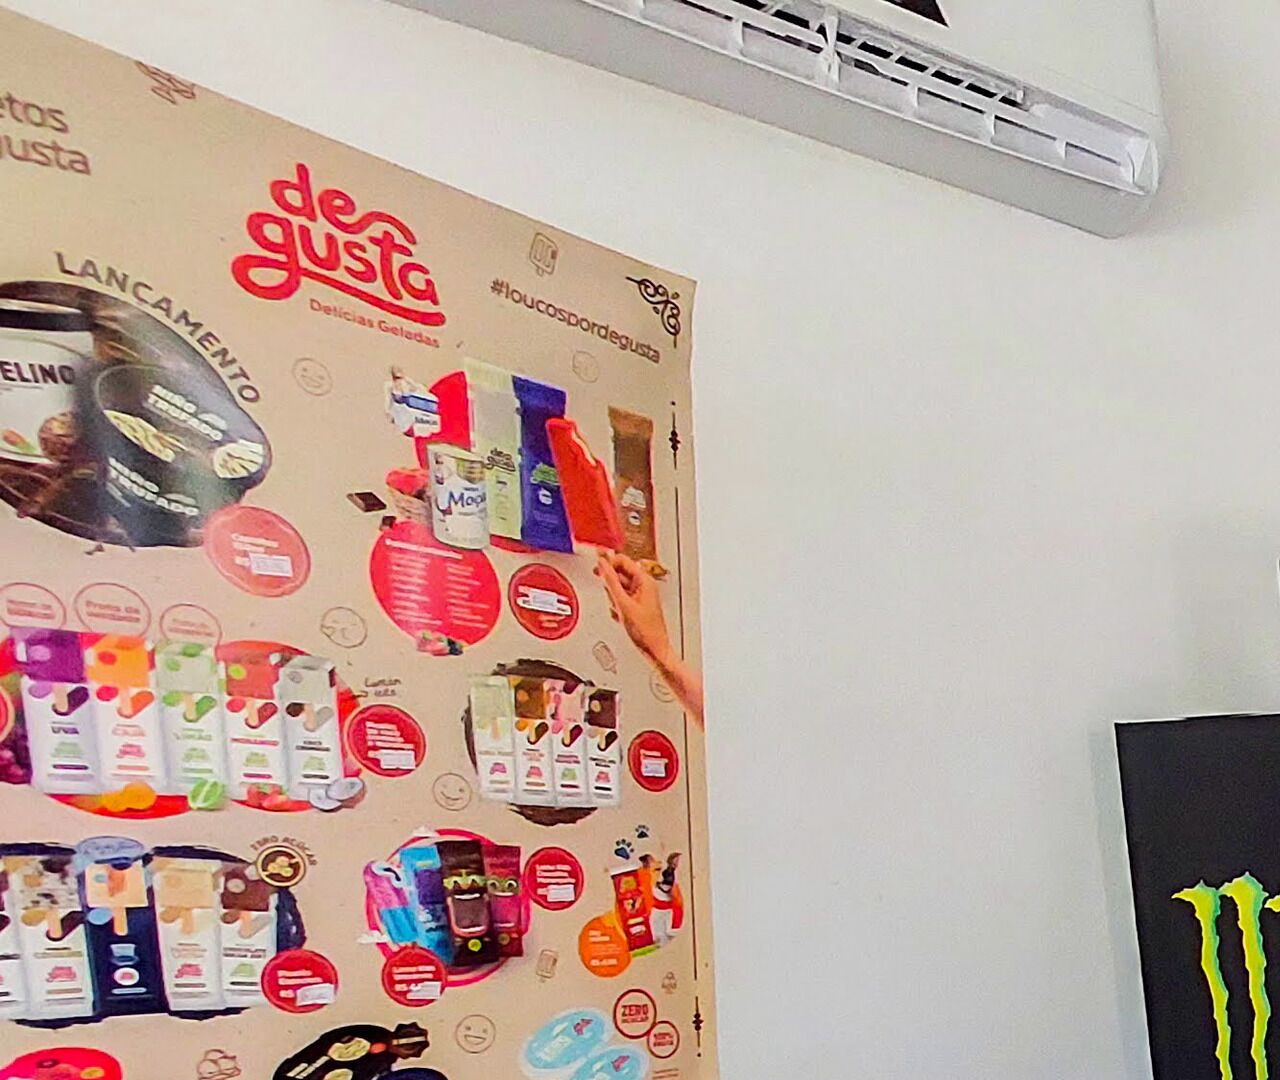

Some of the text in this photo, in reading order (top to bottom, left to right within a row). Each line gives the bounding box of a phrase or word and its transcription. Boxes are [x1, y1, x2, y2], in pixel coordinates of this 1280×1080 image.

[0, 92, 69, 134] tos
[0, 135, 91, 176] usta
[231, 206, 447, 328] gusta
[490, 277, 662, 364] #loucospordegusta
[620, 1003, 650, 1017] ZERO
